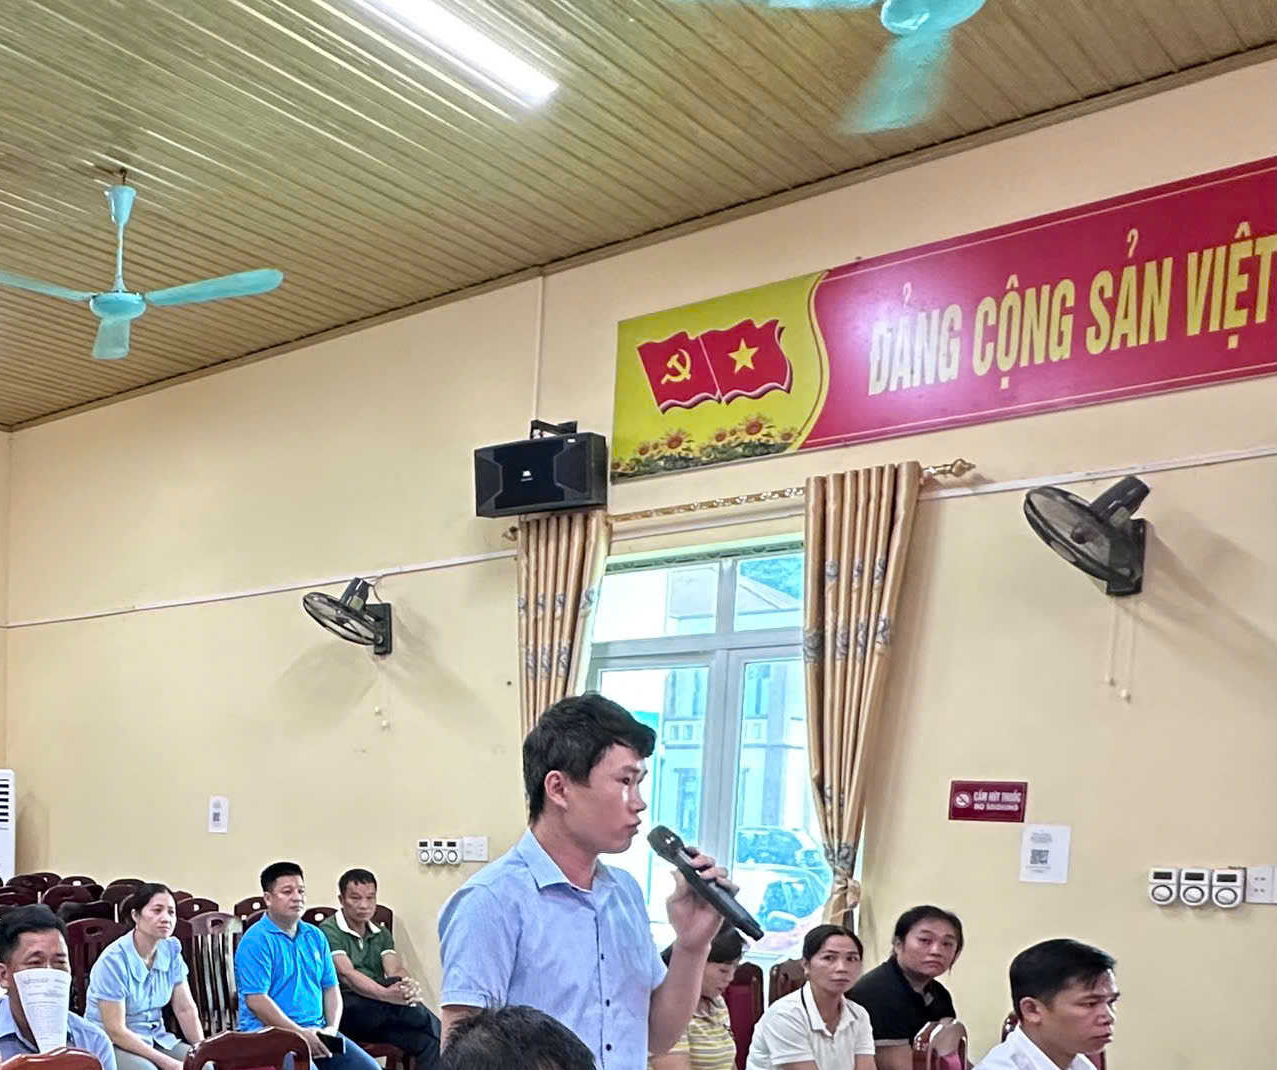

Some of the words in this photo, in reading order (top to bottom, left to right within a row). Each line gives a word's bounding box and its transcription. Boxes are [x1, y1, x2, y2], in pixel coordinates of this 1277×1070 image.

[867, 282, 962, 396] ĐẢNG
[972, 274, 1075, 390] CỘNG
[1086, 228, 1173, 356] SẢN
[1186, 221, 1277, 349] VIỆT
